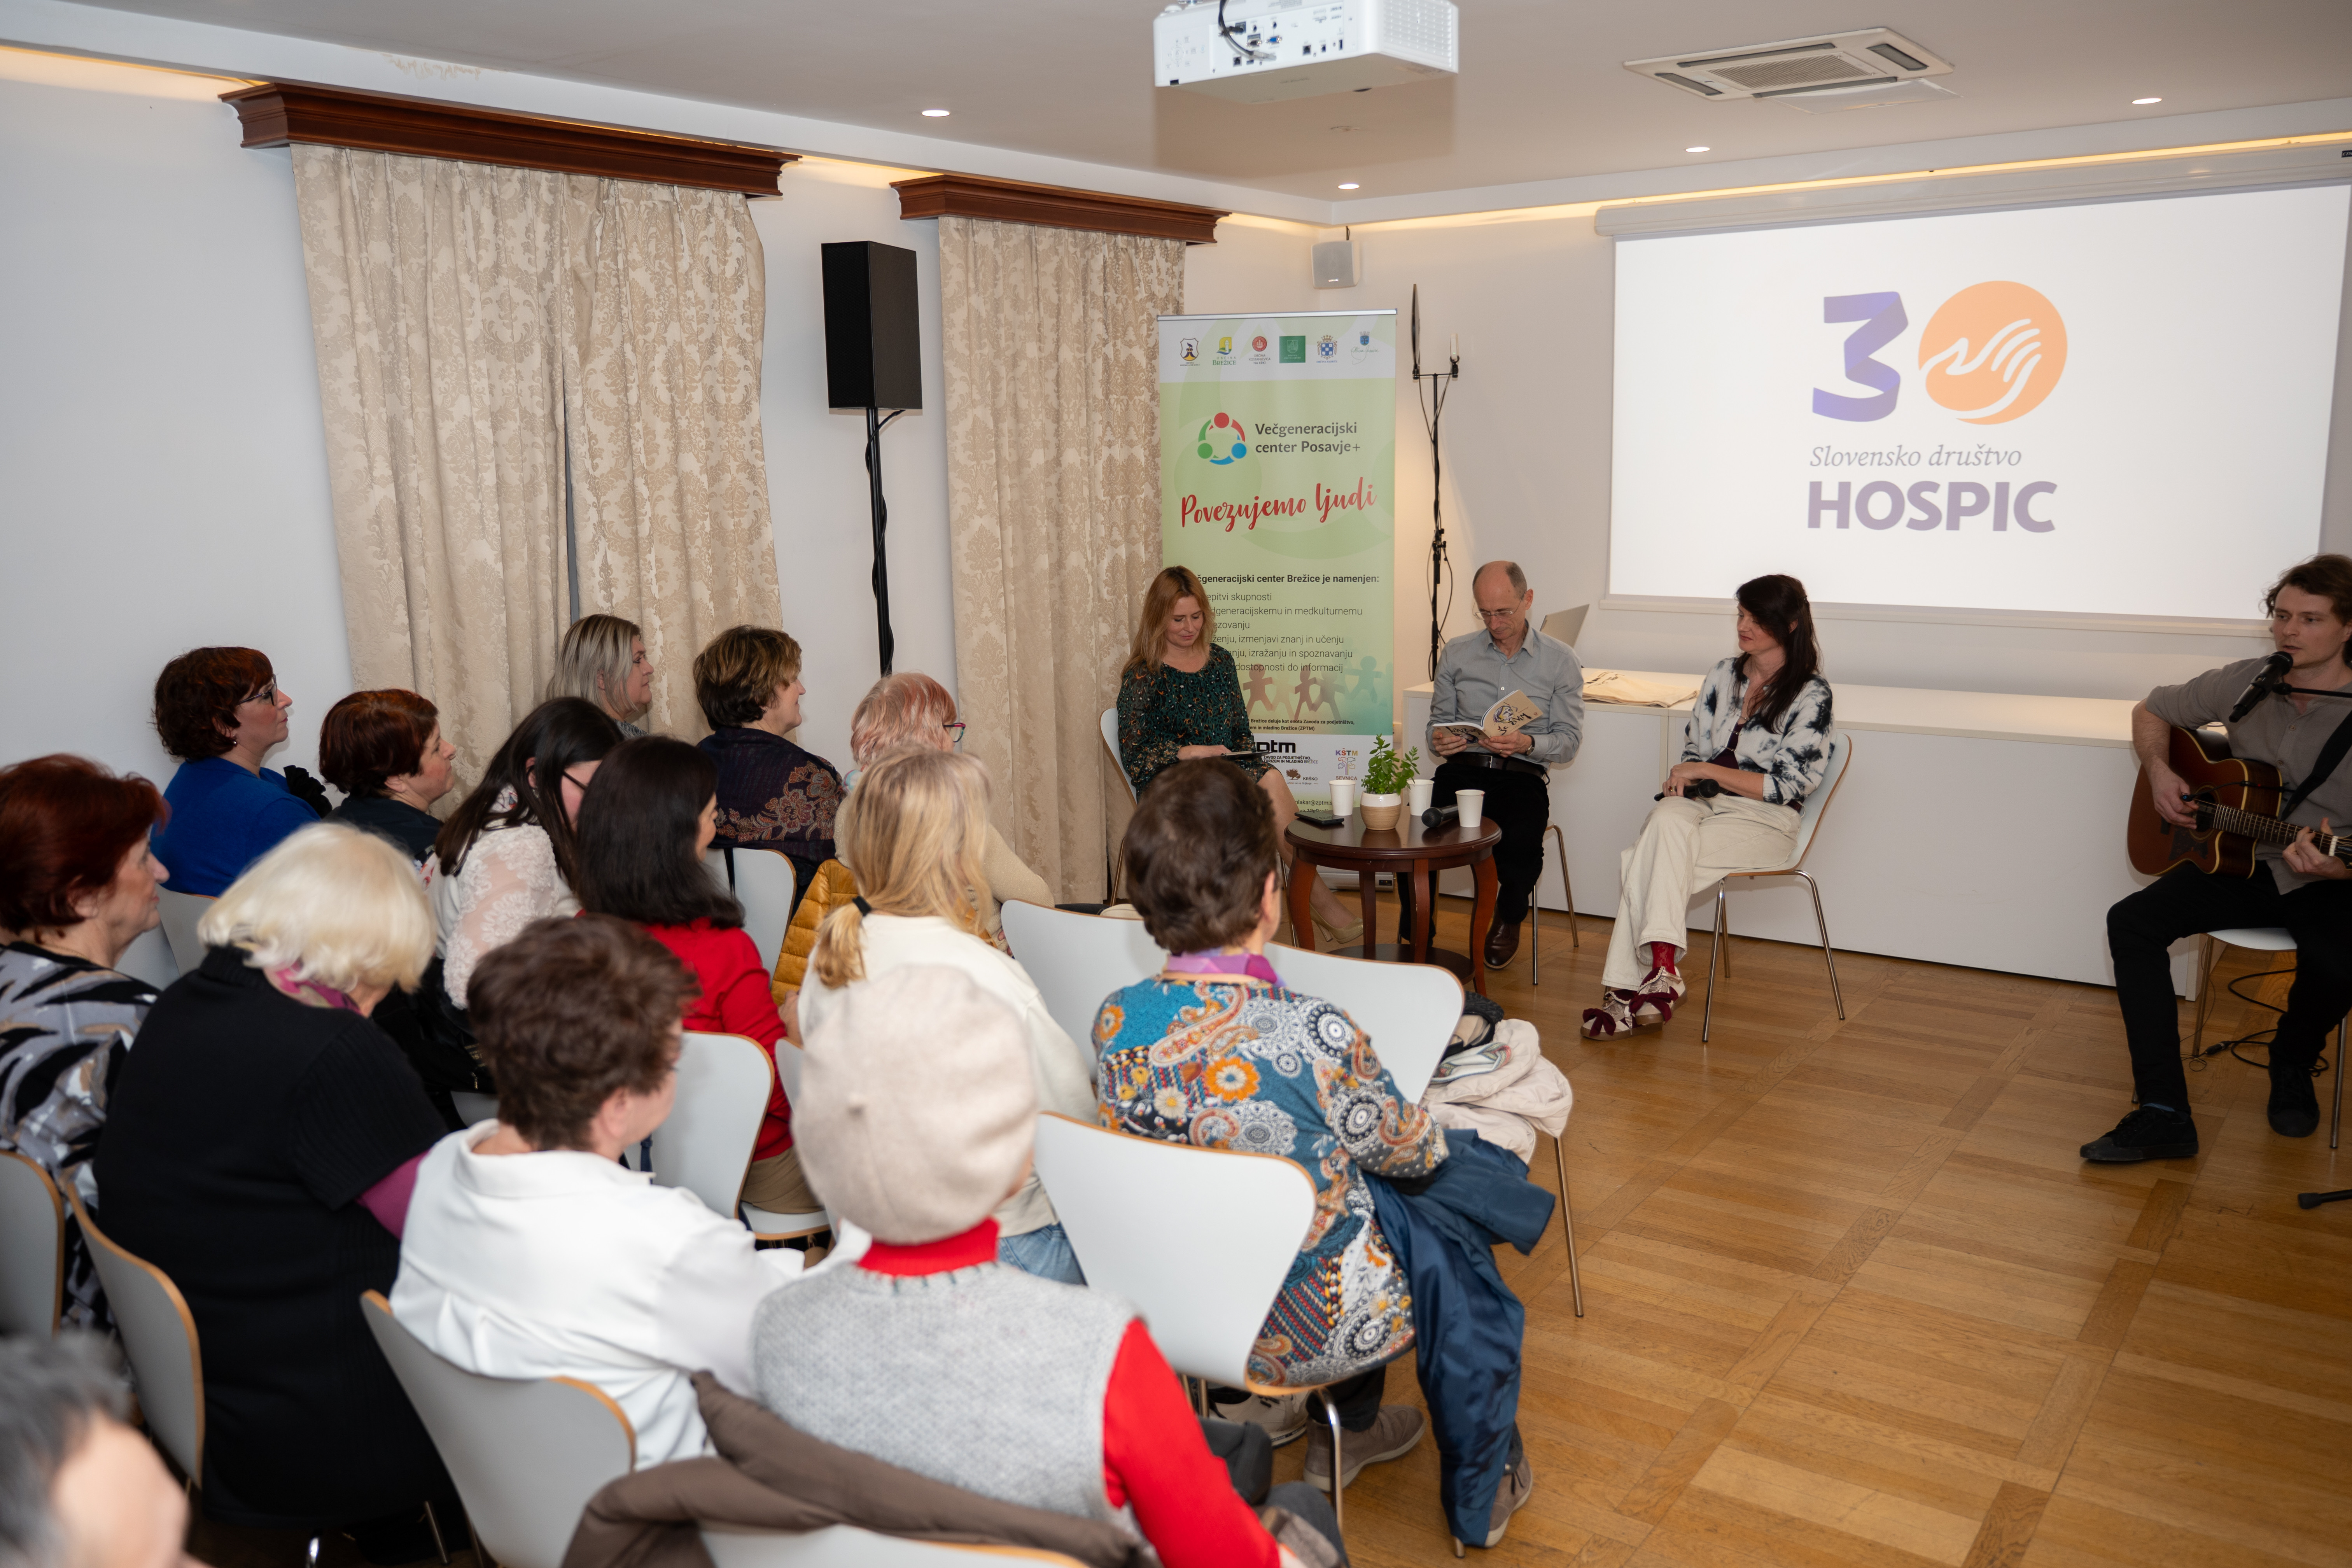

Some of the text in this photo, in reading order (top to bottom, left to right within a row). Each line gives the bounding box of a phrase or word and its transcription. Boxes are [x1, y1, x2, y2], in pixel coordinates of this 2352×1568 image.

[1255, 422, 1357, 438] Večgeneracijski
[1255, 441, 1361, 455] center Posavje+
[1810, 443, 2022, 467] Slovensko društvo
[1181, 477, 1377, 532] Povezujemo ljudi
[1808, 480, 2058, 533] HOSPIC
[1197, 574, 1254, 584] čgeneracijski
[1287, 574, 1320, 583] Brežice
[1321, 574, 1330, 584] je
[1333, 574, 1379, 584] namenjen:
[1207, 593, 1272, 602] epitvi skupnosti
[1211, 607, 1282, 617] dgeneracijskemu
[1295, 607, 1363, 615] medkulturnemu
[1212, 635, 1236, 644] ženju,
[1239, 635, 1278, 645] izmenjavi
[1281, 635, 1304, 645] znanj
[1316, 635, 1344, 645] učenju
[1249, 649, 1286, 659] izražanju
[1299, 649, 1353, 660] spoznavanju
[1236, 663, 1343, 674] dostopnosti do informacij
[1256, 740, 1296, 753] ptm
[1335, 748, 1358, 756] KŠTM
